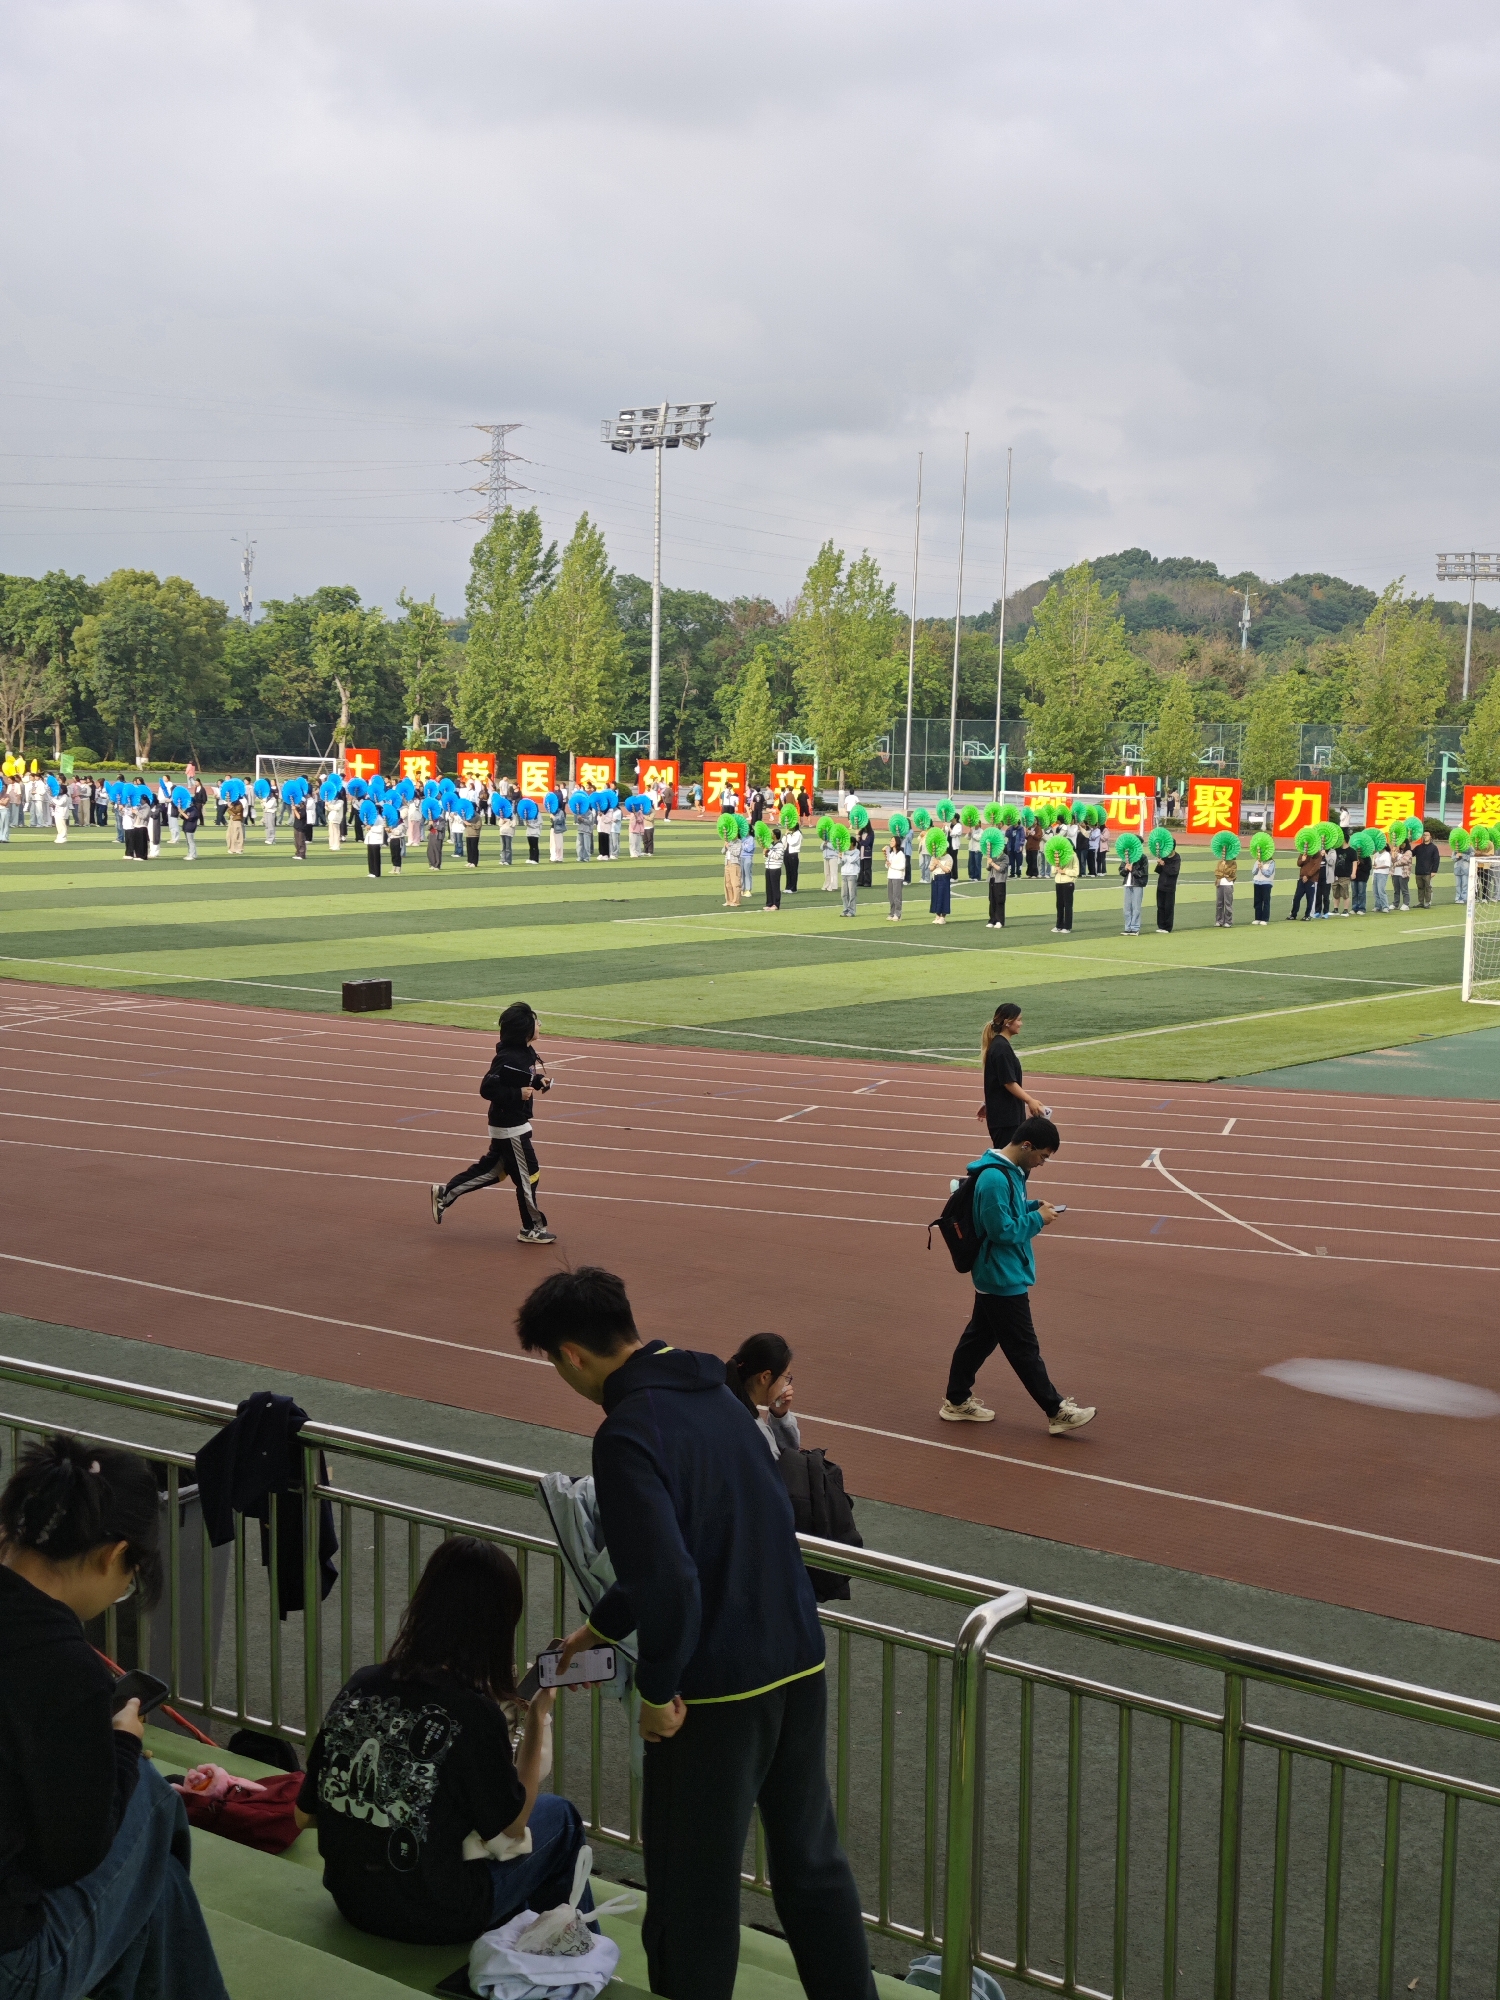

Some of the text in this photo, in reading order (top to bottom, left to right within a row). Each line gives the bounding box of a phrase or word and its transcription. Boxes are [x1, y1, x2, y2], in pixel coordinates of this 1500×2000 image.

[521, 762, 550, 797] 医
[580, 763, 610, 791] 智
[1107, 783, 1148, 826] 心
[1193, 785, 1234, 828] 聚
[1279, 787, 1323, 831] 力
[1375, 791, 1416, 833] 勇
